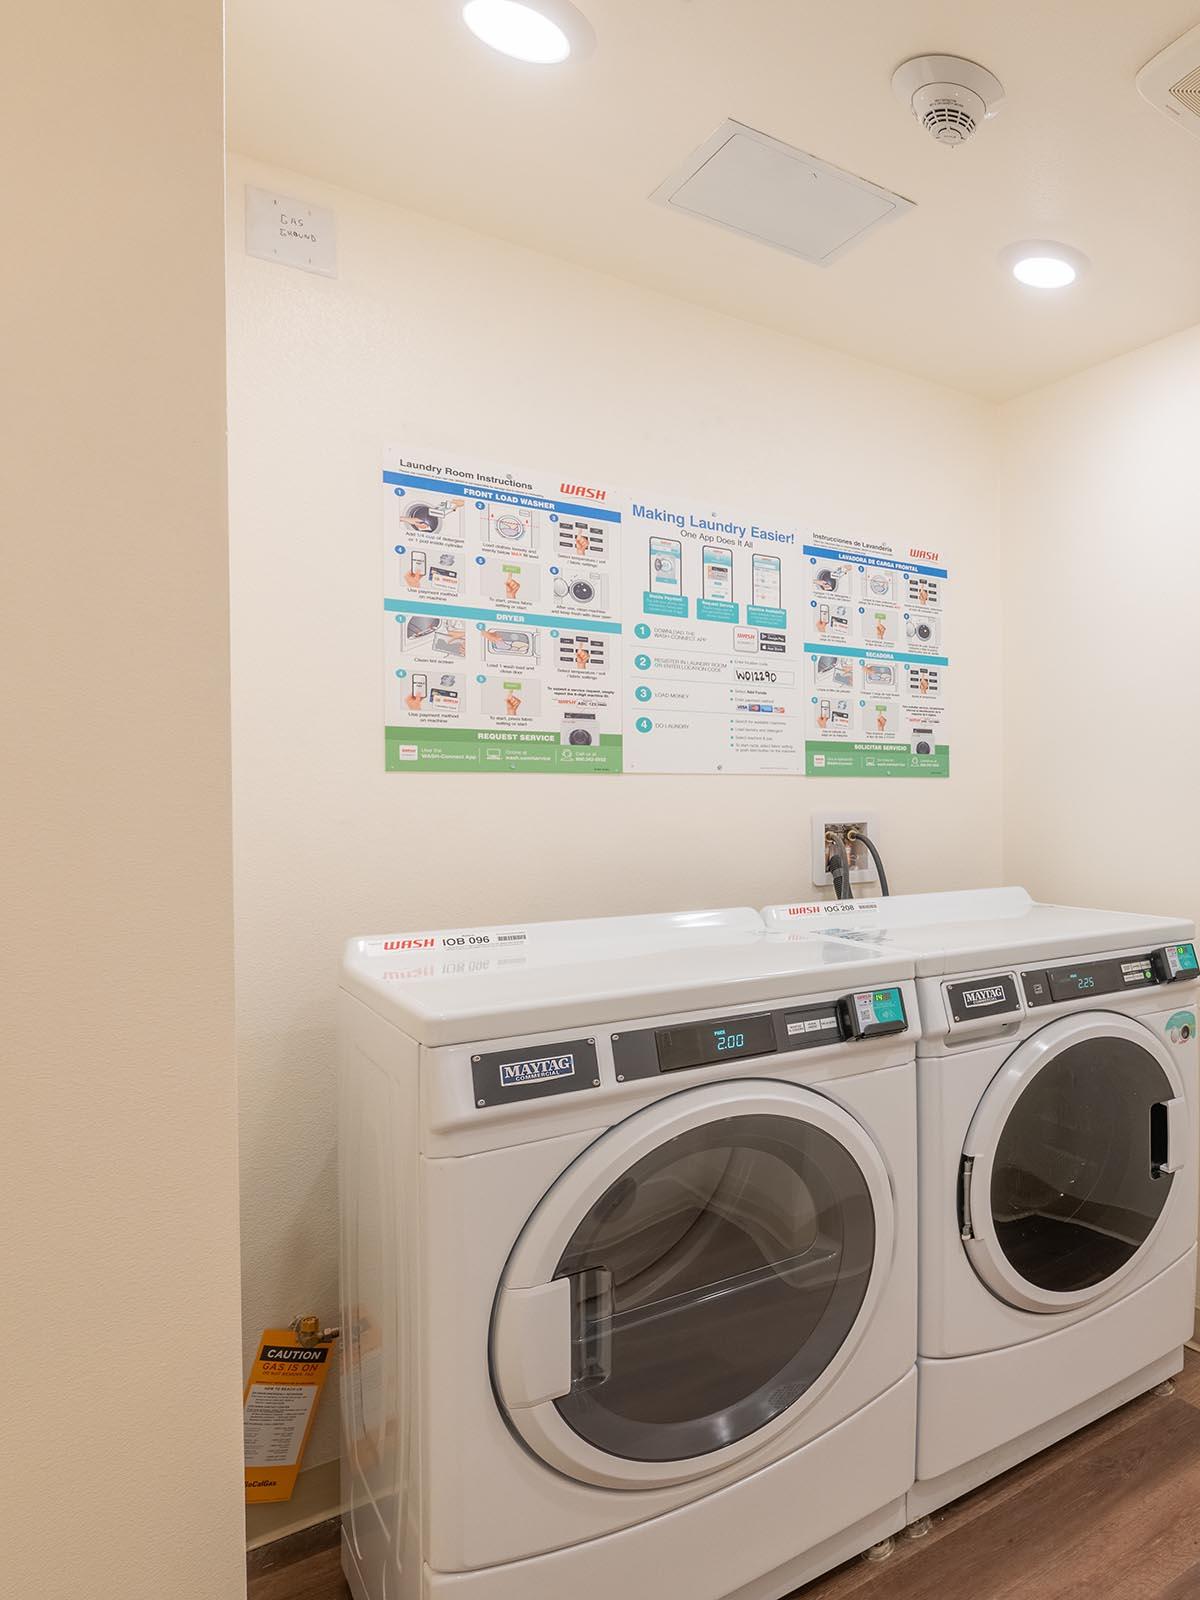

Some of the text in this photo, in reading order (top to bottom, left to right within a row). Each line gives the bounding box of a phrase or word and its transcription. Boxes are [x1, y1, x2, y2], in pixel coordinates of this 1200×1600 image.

[280, 214, 304, 227] GAS
[400, 459, 442, 475] Laundry
[445, 467, 474, 480] Room
[477, 473, 533, 490] Instructions
[560, 483, 606, 500] WASH
[464, 488, 493, 500] FRONT
[496, 493, 518, 503] LOAD
[520, 498, 555, 510] WASHER
[632, 504, 795, 544] Making Laundry Easier!
[680, 530, 753, 548] One App Does It All
[812, 532, 852, 546] Instrucciones
[910, 548, 939, 561] WASH
[838, 553, 867, 564] LAVADORA
[876, 560, 894, 569] CARGA
[895, 562, 918, 573] FRONTAL
[496, 613, 525, 623] DRYER
[865, 651, 894, 660] SECADORA
[735, 669, 777, 682] W012290
[478, 733, 555, 742] REQUEST SERVICE
[788, 906, 820, 915] WASH
[384, 935, 490, 951] WASH IOB 096
[966, 989, 1002, 1002] MAYTAG
[717, 1034, 744, 1050] 2.00
[504, 1058, 570, 1078] MAYTAG
[515, 1070, 560, 1081] COMMERCIAL
[267, 1349, 322, 1360] CAUTION
[262, 1362, 318, 1372] GAS IS ON
